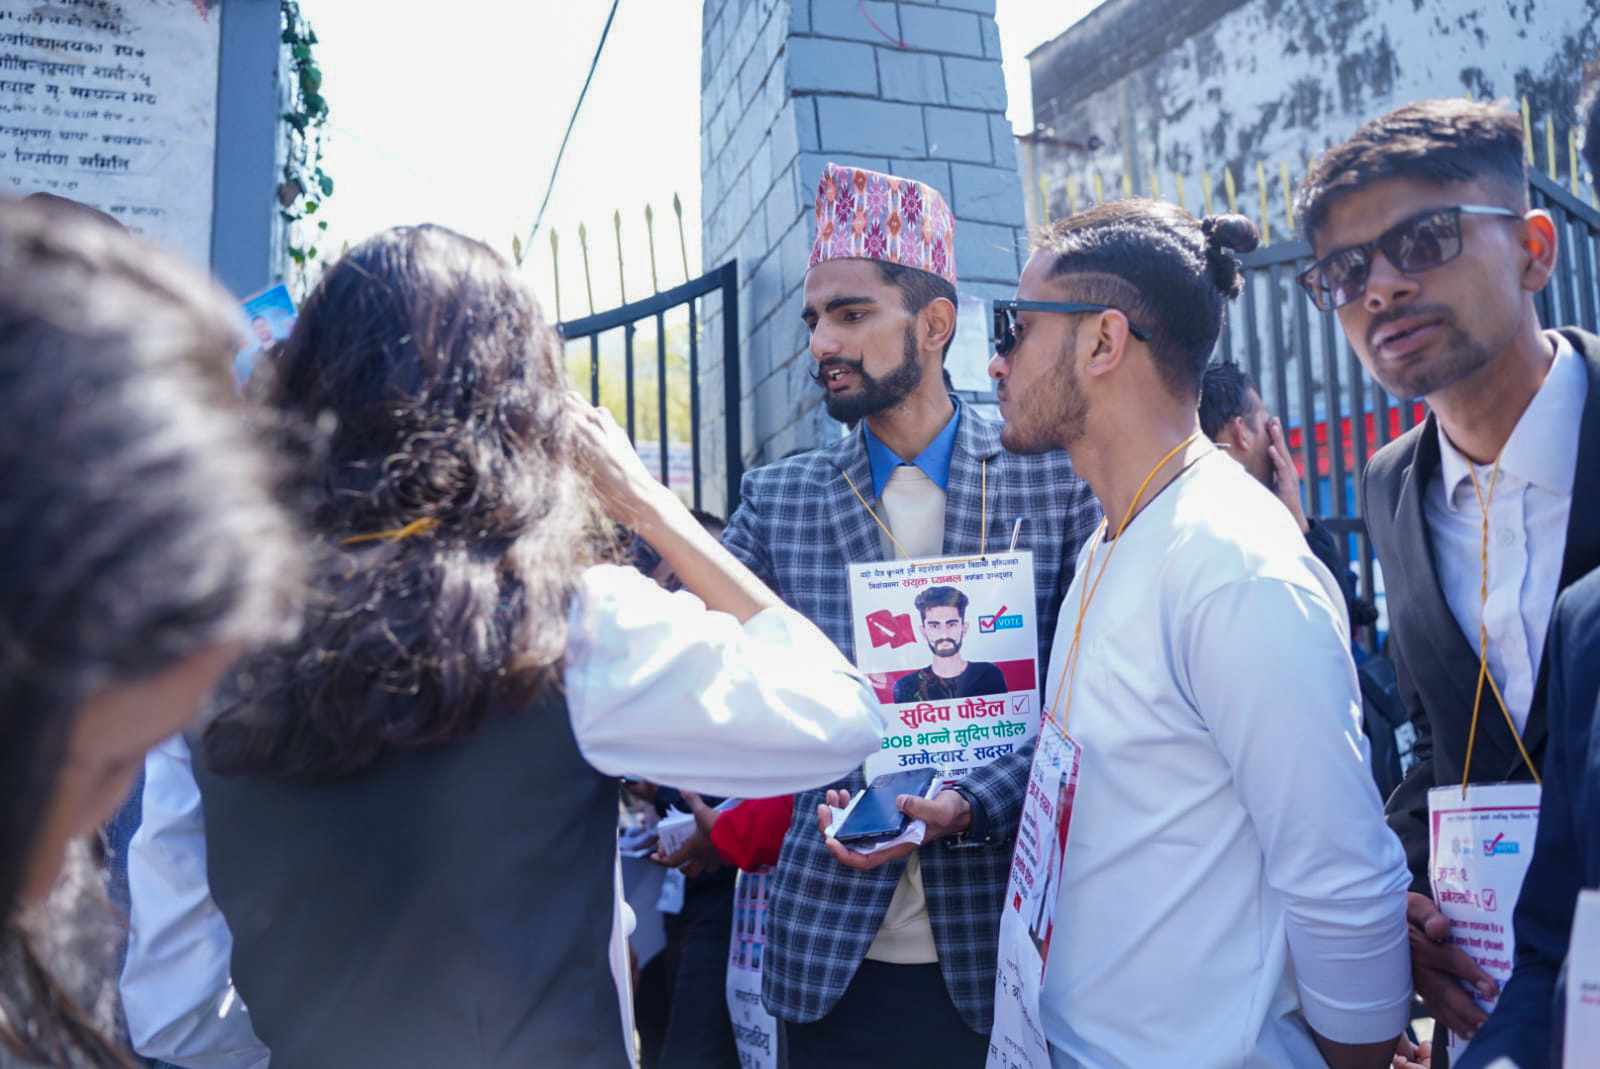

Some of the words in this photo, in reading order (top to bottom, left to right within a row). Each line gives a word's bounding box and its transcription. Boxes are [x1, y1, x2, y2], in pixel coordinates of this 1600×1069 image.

[999, 616, 1021, 626] VOTE
[899, 702, 951, 729] सुदिप
[957, 698, 1006, 719] पौडेल
[917, 728, 951, 746] भन्ने
[954, 724, 990, 748] सुदिप
[992, 720, 1027, 738] पौडेल
